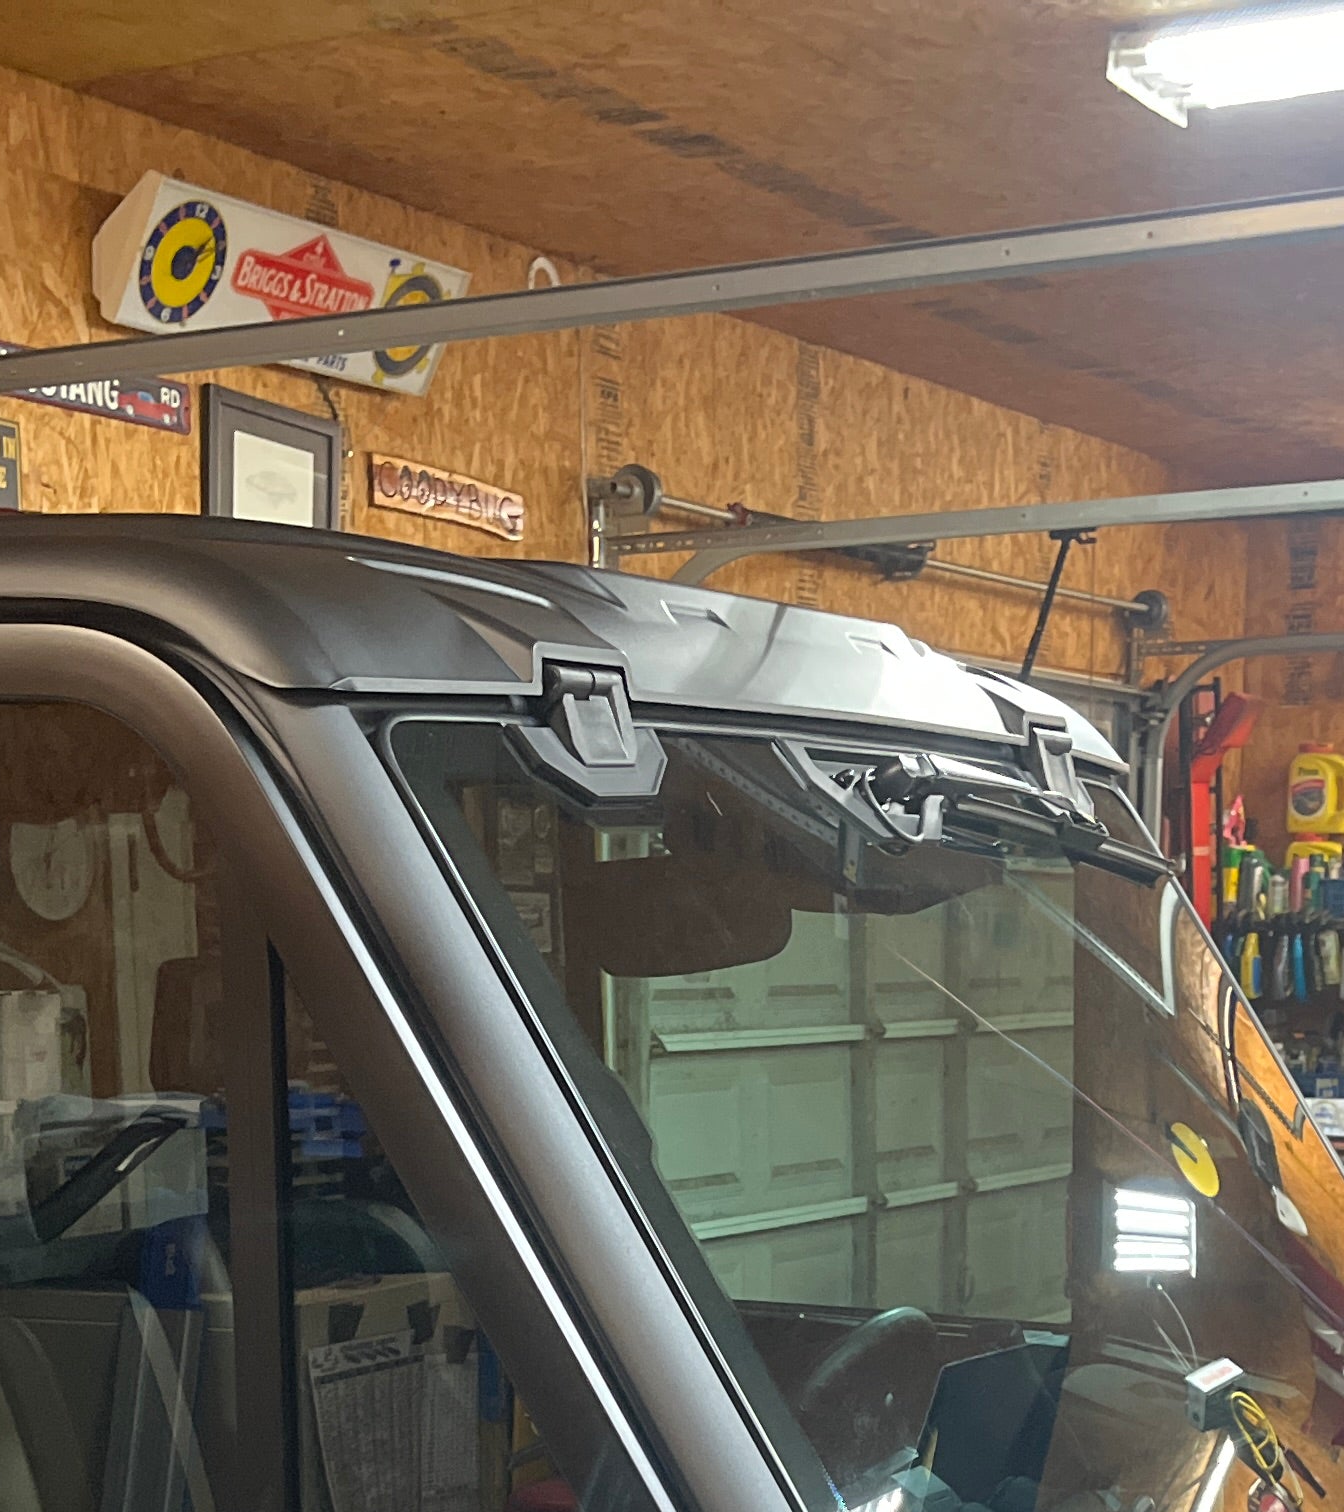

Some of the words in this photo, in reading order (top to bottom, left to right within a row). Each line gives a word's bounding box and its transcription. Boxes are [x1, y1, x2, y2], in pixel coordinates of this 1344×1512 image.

[196, 203, 209, 218] 12
[237, 255, 293, 298] BRIGGS
[161, 387, 181, 408] RD
[2, 436, 16, 459] IN
